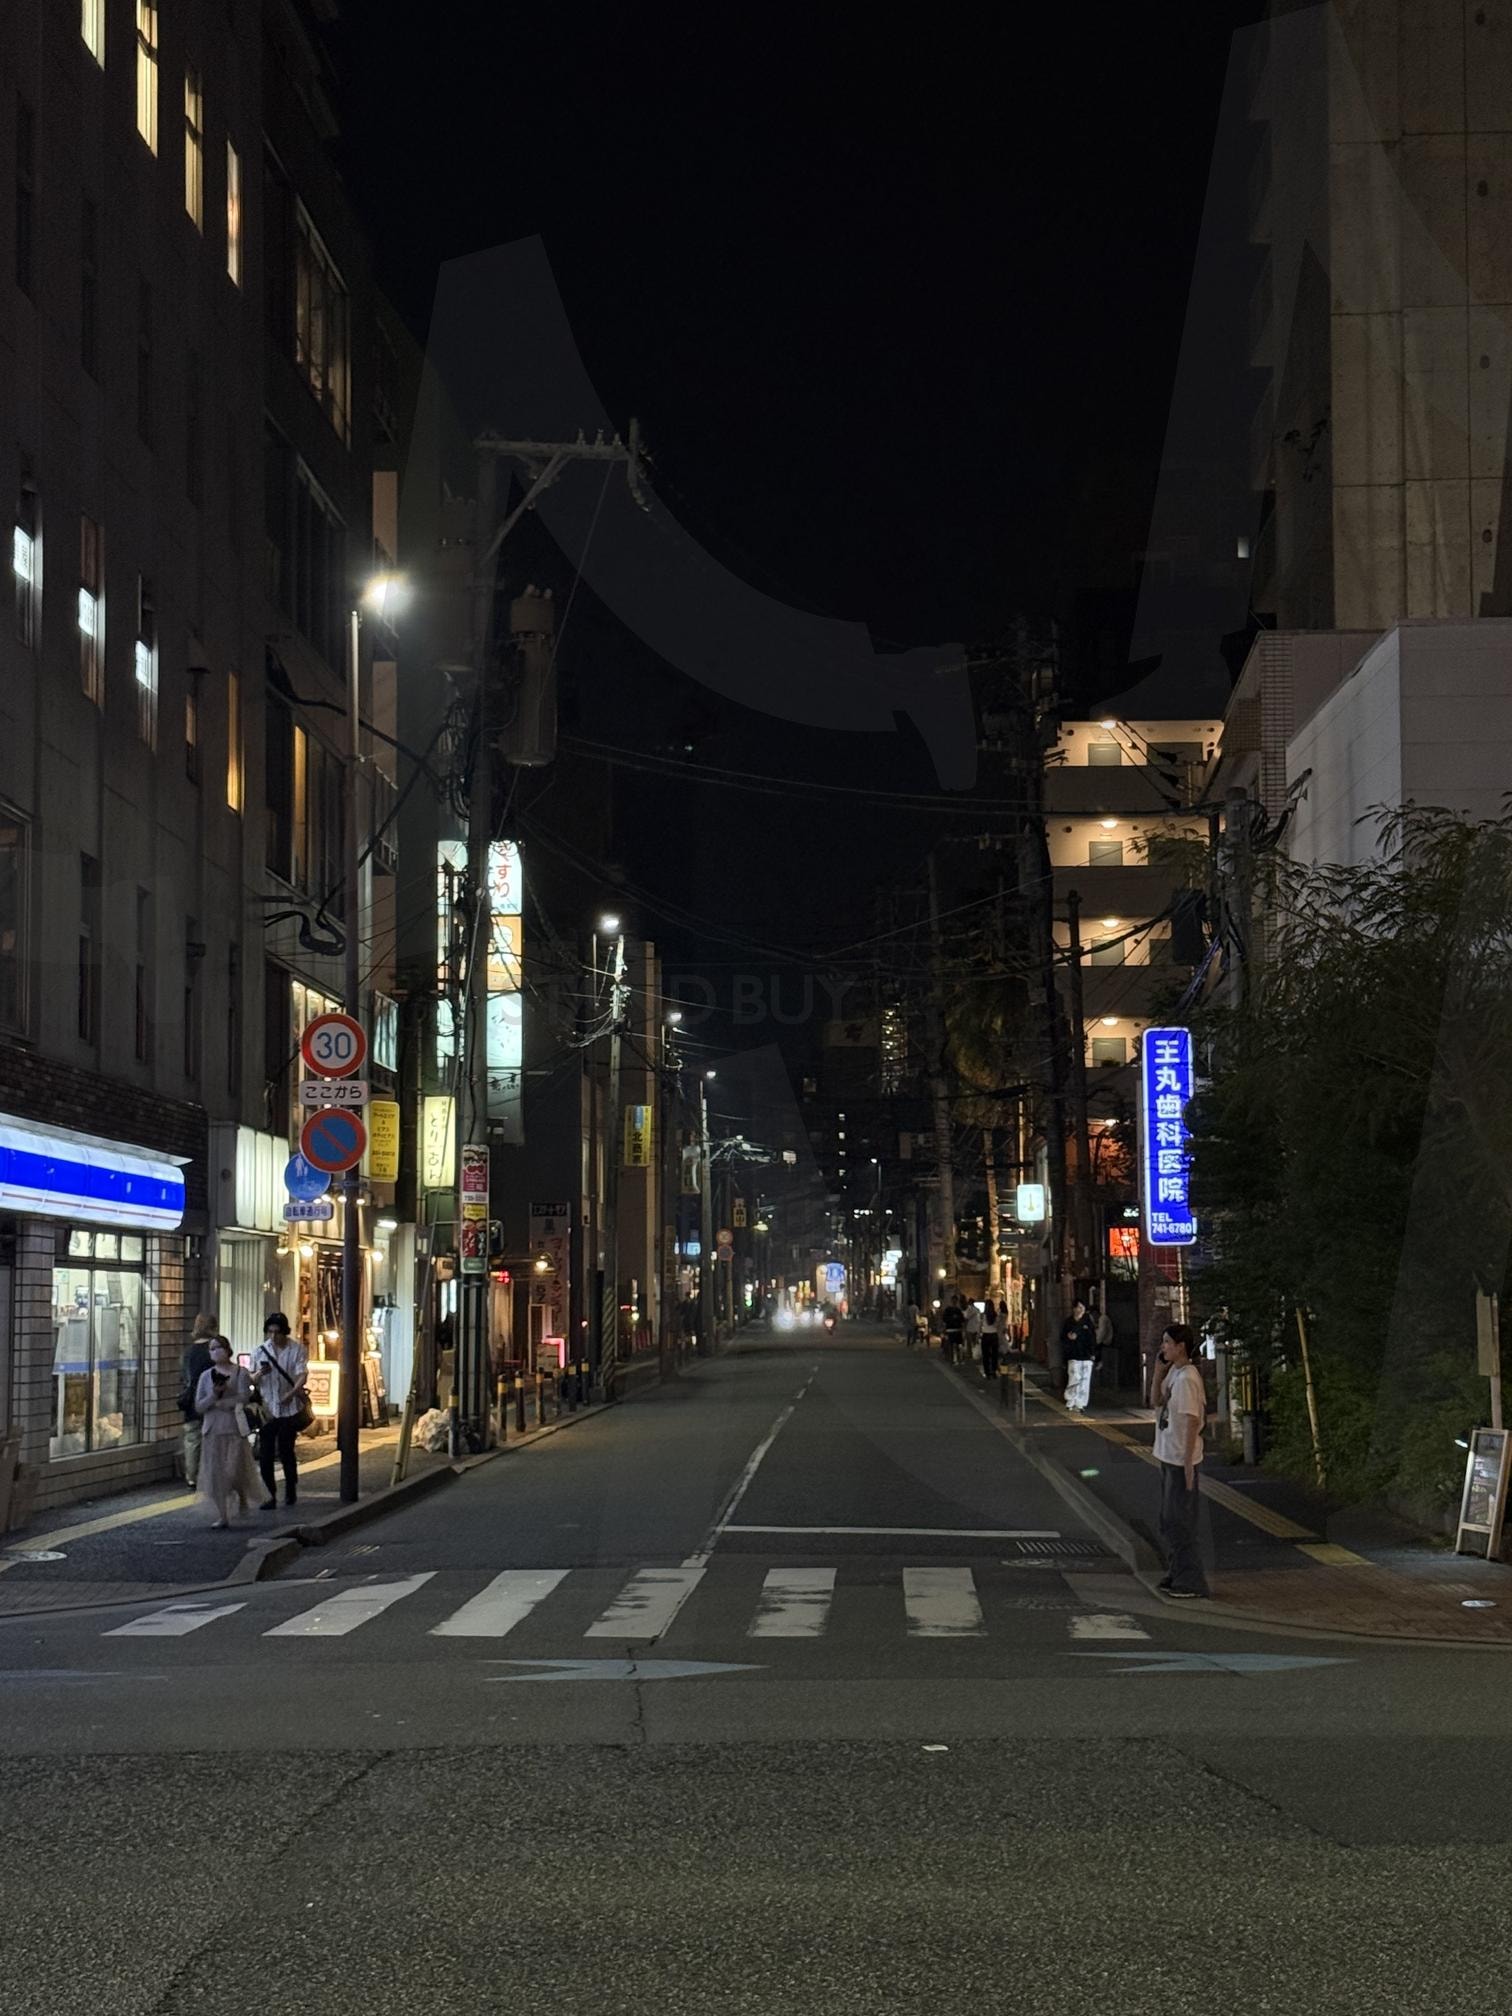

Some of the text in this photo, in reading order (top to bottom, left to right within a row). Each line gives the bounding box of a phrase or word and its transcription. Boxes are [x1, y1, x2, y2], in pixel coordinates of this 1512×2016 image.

[316, 1031, 352, 1060] 30
[305, 1085, 362, 1099] ここから
[1154, 1039, 1185, 1204] 王丸歯科医院
[1151, 1212, 1173, 1223] TEL
